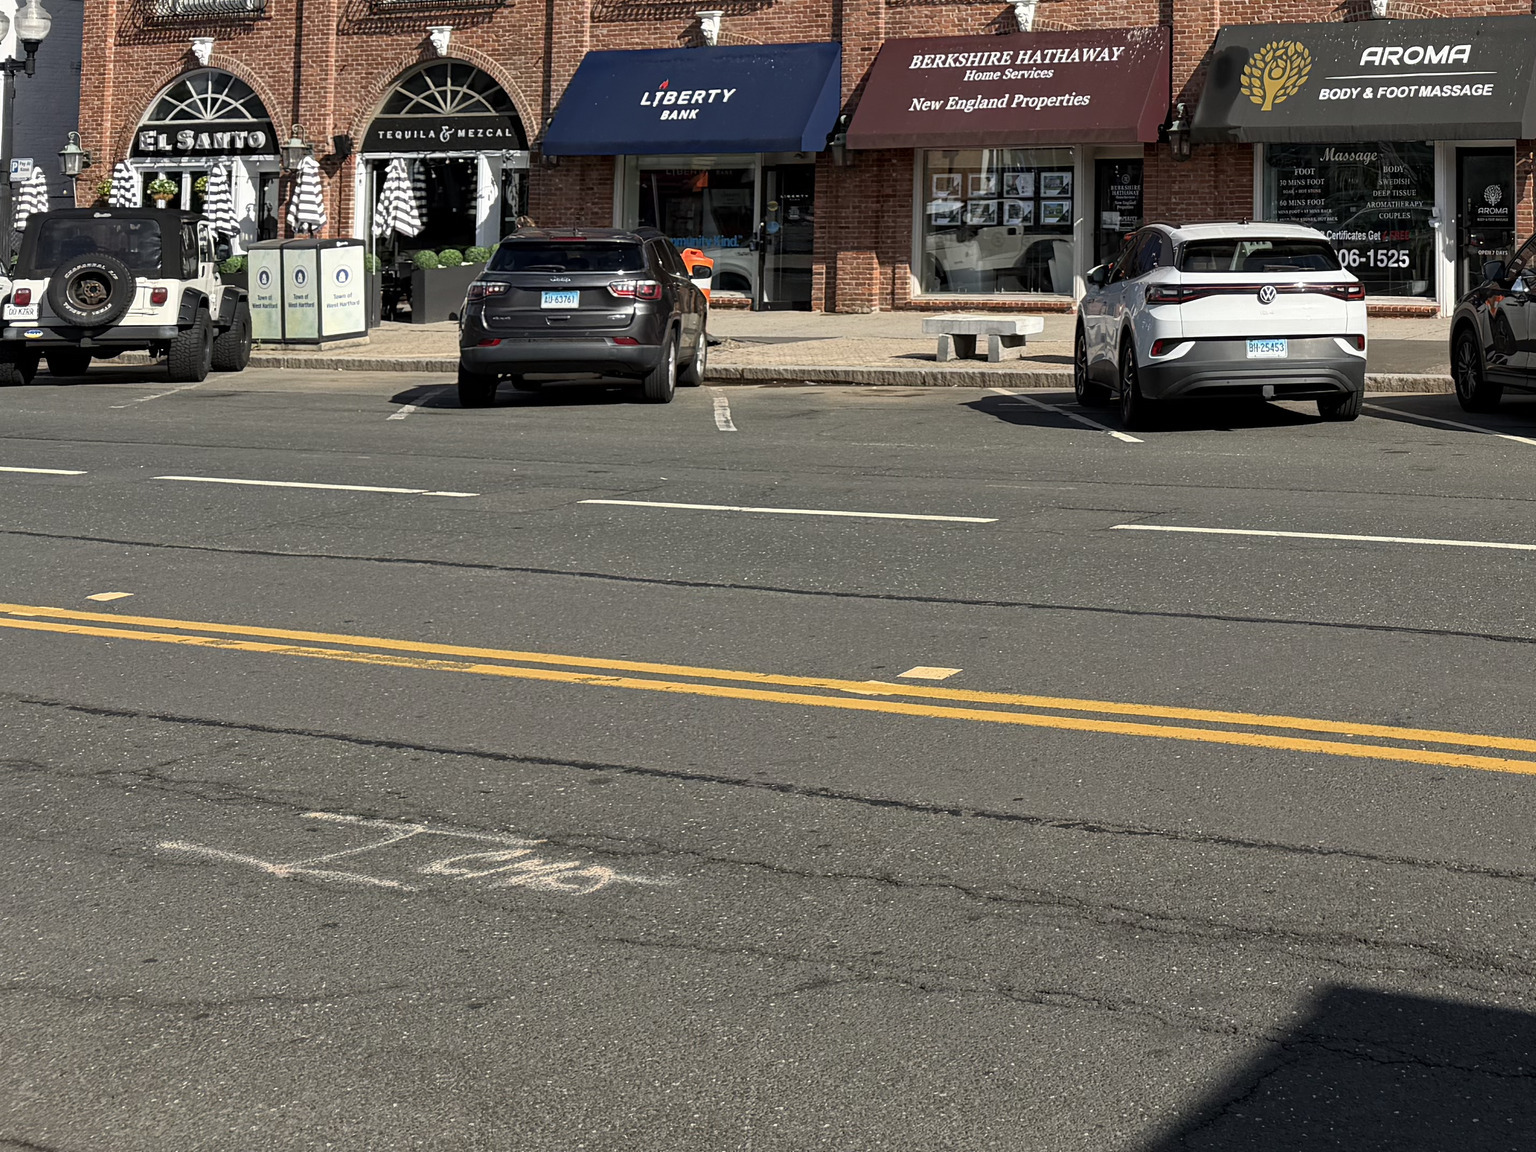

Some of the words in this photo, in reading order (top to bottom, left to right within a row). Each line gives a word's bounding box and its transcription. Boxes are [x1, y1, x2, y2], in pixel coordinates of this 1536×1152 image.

[909, 51, 1013, 69] BERKSHIRE
[1015, 46, 1125, 65] HATHAWAY
[1359, 44, 1472, 66] AROMA
[963, 69, 1001, 81] Home
[1002, 67, 1054, 80] Services
[640, 88, 736, 107] LIBERTY
[1319, 87, 1361, 100] BODY
[1363, 87, 1374, 99] &
[1377, 86, 1418, 98] FOOT
[1419, 84, 1494, 98] MASSAGE
[908, 98, 943, 111] New
[945, 94, 1010, 113] England
[1011, 92, 1090, 111] Properties
[660, 109, 699, 120] BANK
[378, 130, 435, 139] TEQUILA
[440, 126, 455, 142] &
[458, 129, 512, 138] MEZCAL
[1320, 147, 1378, 165] Massage
[1294, 168, 1316, 176] FOOT
[1383, 165, 1405, 173] BODY
[1307, 198, 1325, 206] FOOT
[1326, 230, 1367, 241] Certificates
[1368, 230, 1381, 241] Get
[1334, 249, 1410, 268] 06-1525
